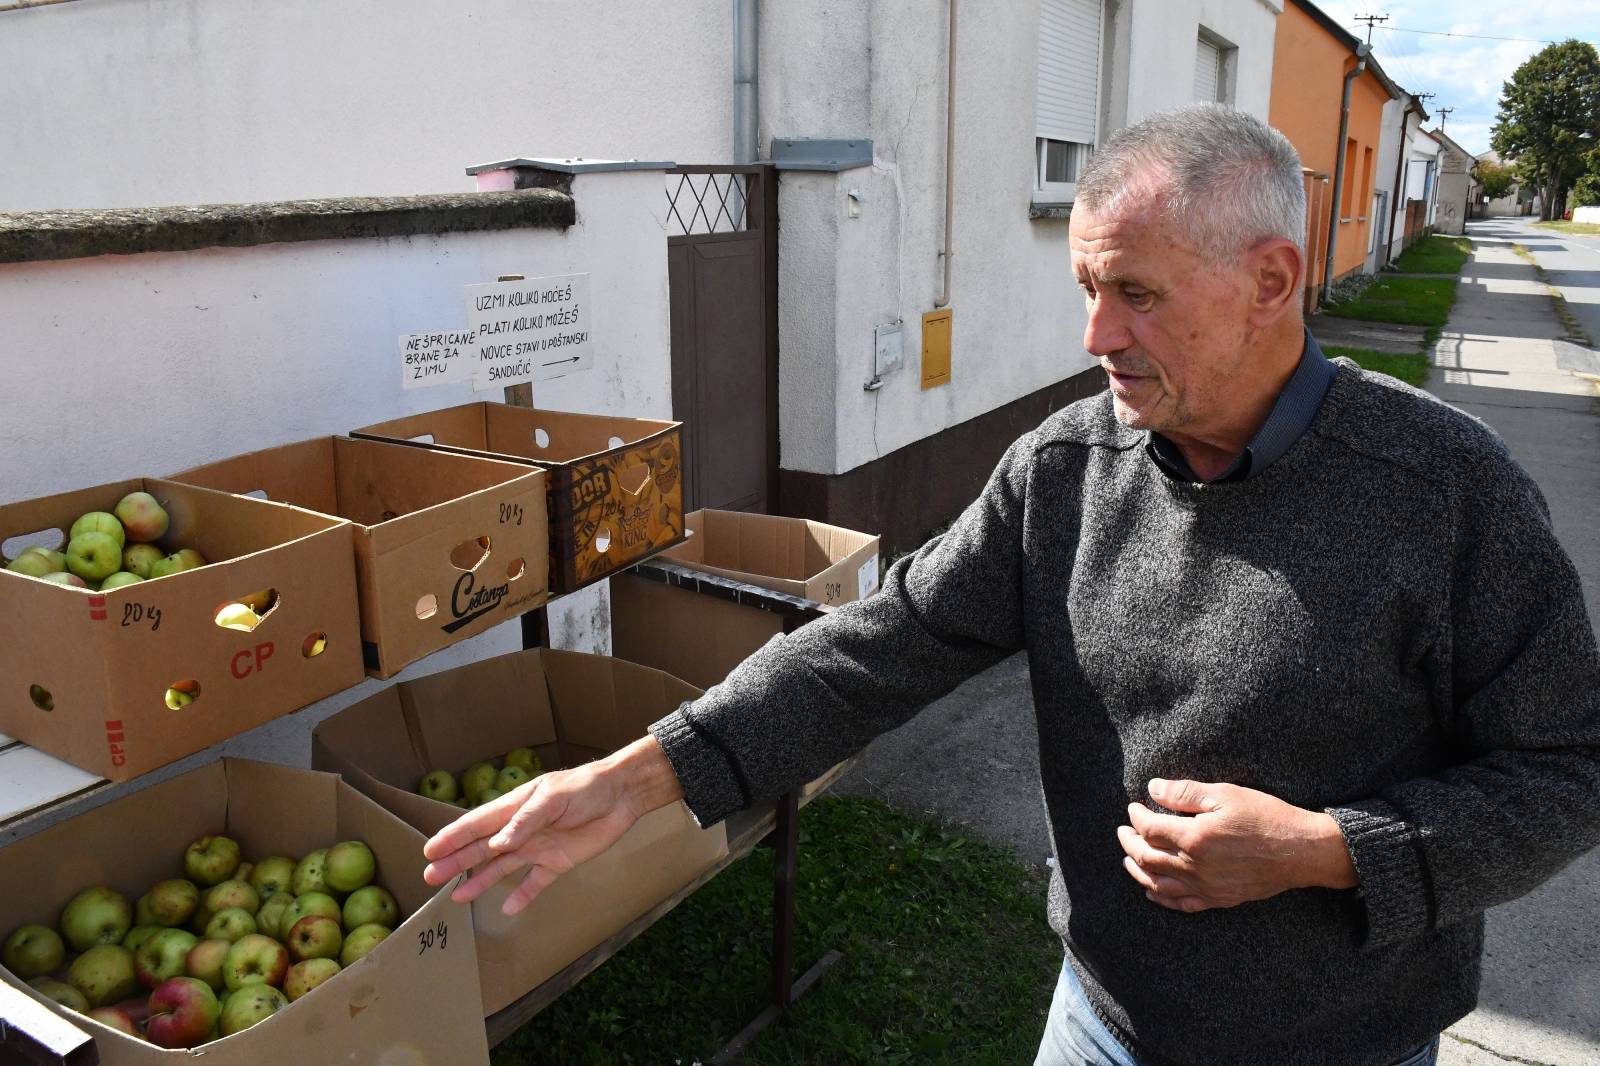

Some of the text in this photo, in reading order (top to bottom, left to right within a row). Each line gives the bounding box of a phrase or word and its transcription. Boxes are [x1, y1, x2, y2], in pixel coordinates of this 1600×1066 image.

[476, 294, 505, 311] UZMI
[508, 291, 538, 307] KOLIKO
[479, 304, 579, 336] PLATI KOLIKO MOŽEŠ
[405, 348, 459, 365] BRANE ZA
[480, 332, 588, 361] NOVCE STAVI U POŠTANSKI
[414, 362, 448, 379] ZIMU
[499, 503, 512, 524] 20
[121, 602, 143, 627] 20
[230, 641, 275, 680] CP
[111, 743, 126, 767] CP
[418, 929, 434, 955] 30
